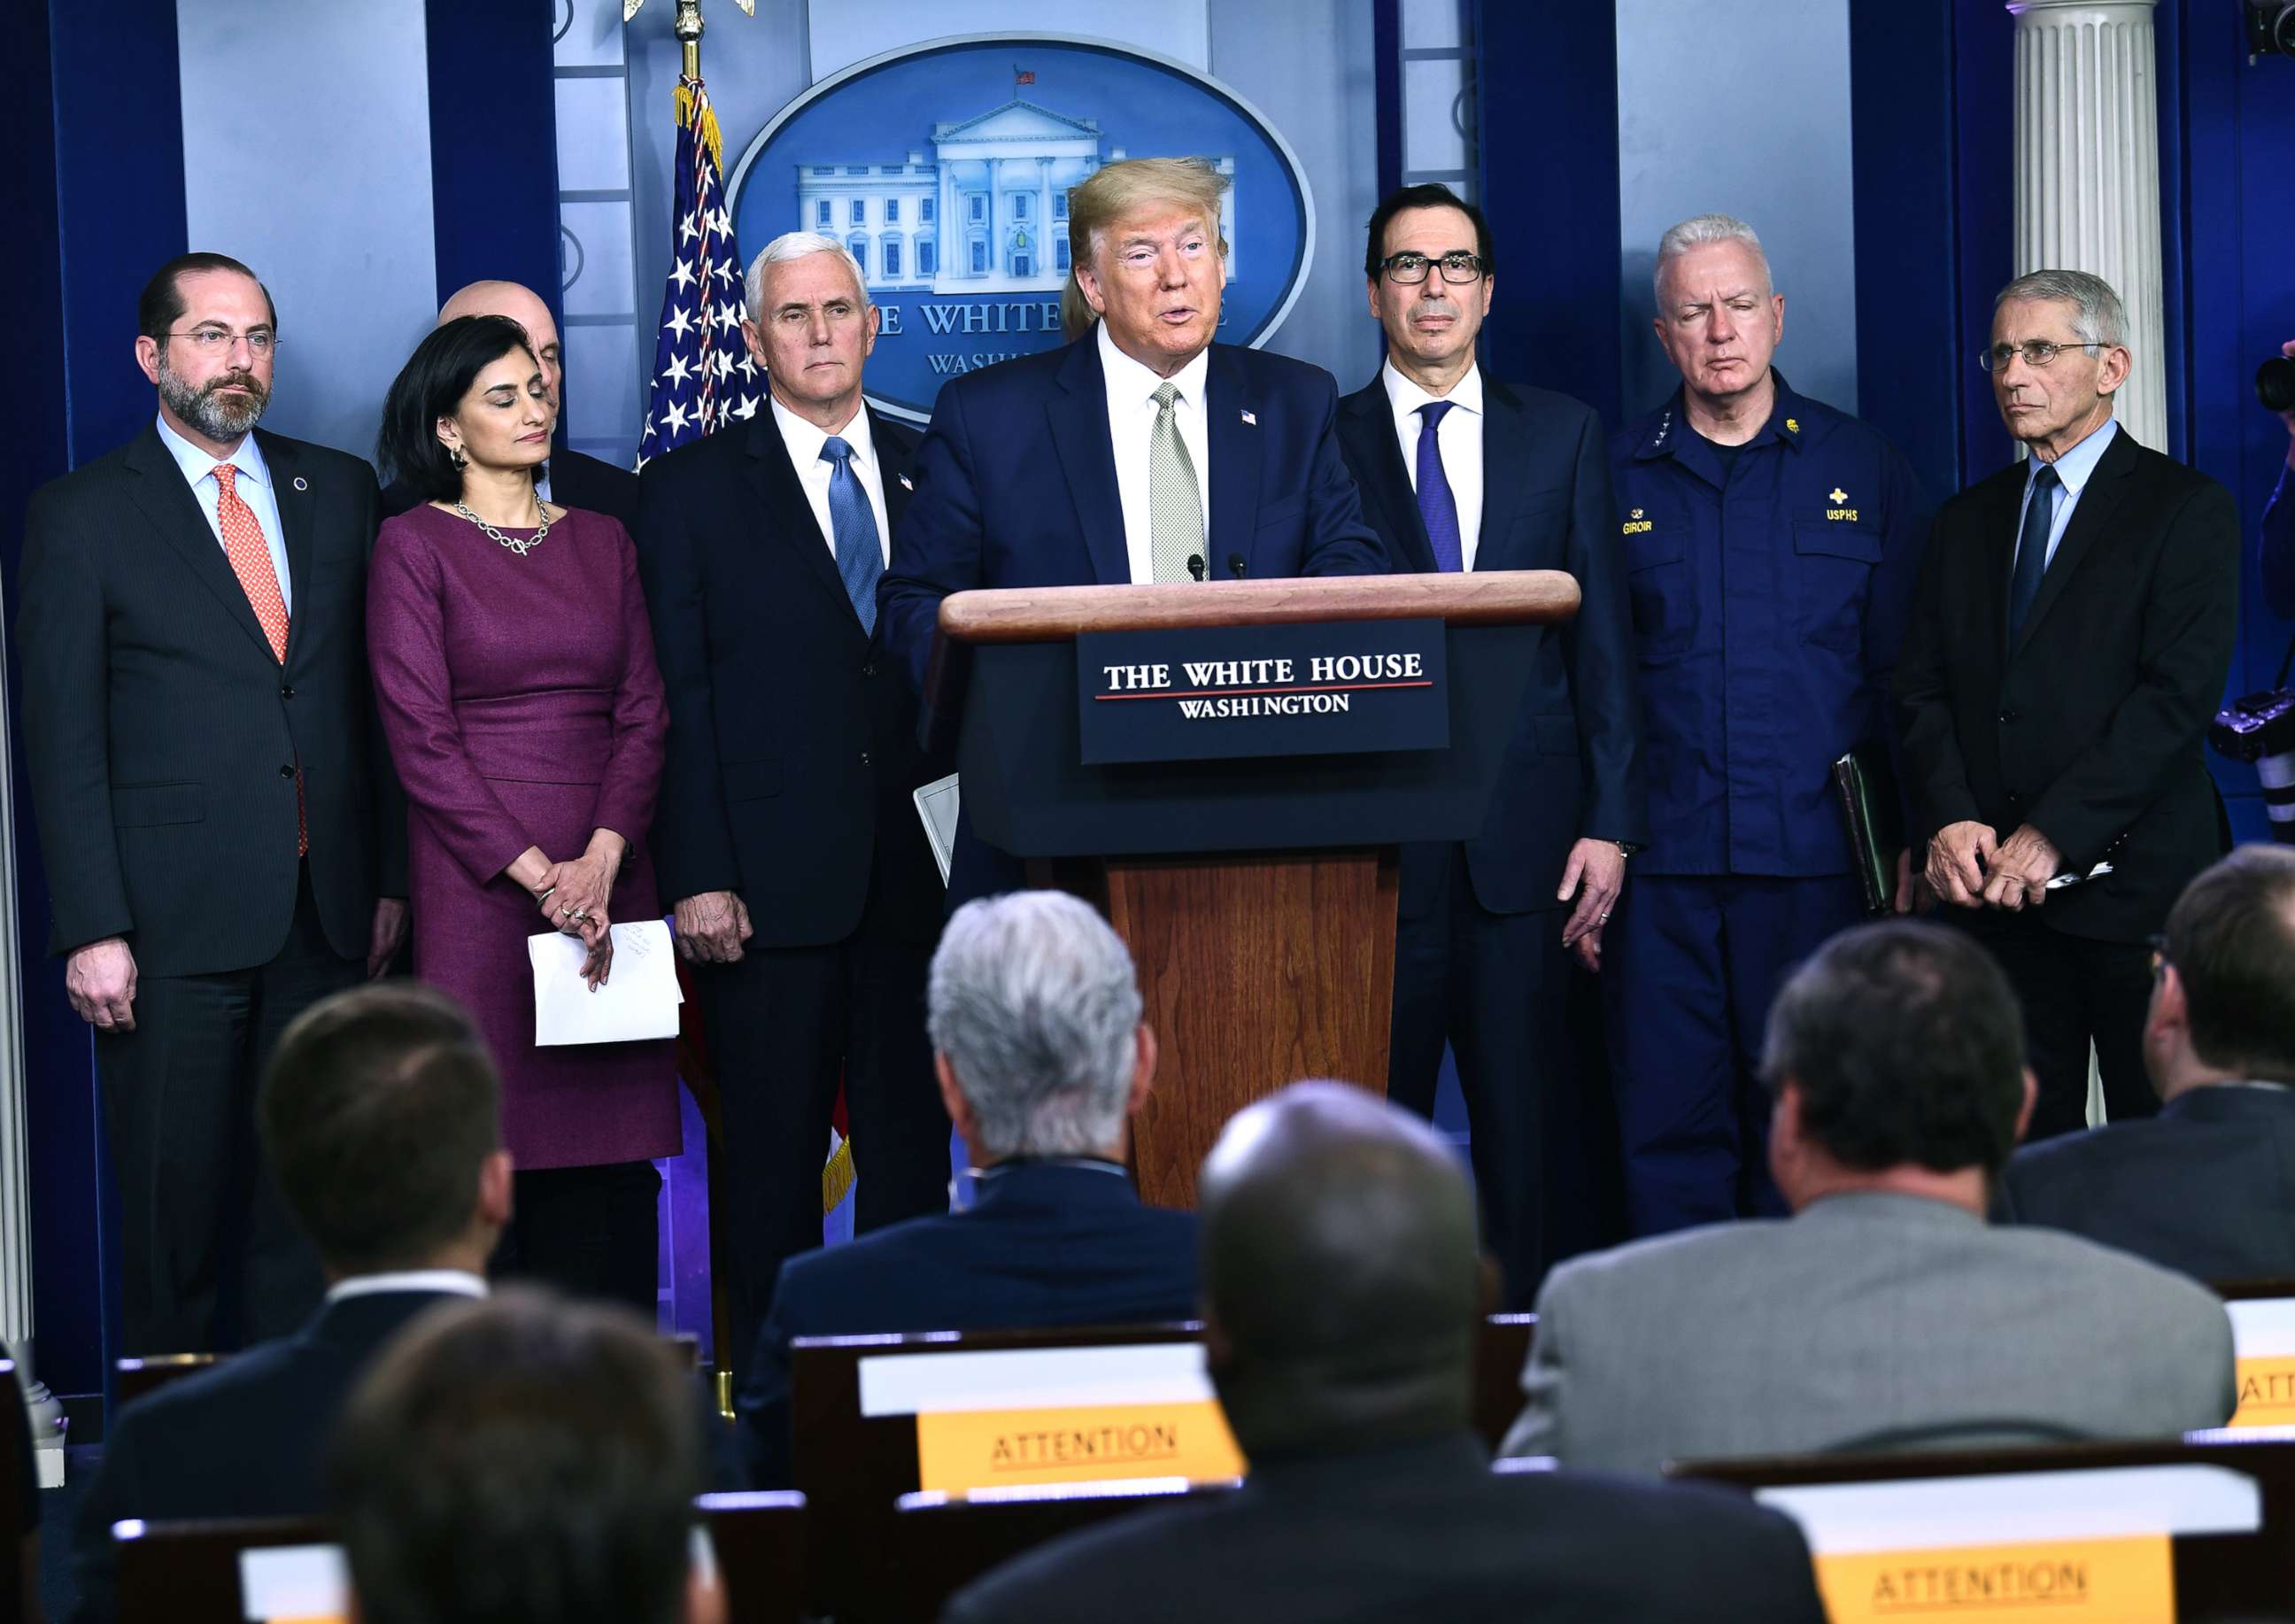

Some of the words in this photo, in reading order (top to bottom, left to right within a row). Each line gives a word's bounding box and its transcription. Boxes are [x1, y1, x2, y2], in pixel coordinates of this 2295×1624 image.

[920, 302, 1061, 335] WHITE
[1622, 521, 1652, 535] GIROIR
[1827, 508, 1858, 522] USPHS
[1103, 664, 1171, 691] THE
[1181, 659, 1294, 687] WHITE
[1310, 653, 1423, 682] HOUSE
[1178, 693, 1350, 719] WASHINGTON
[992, 1422, 1178, 1465] ATTENTION
[1872, 1560, 2089, 1601] ATTENTION
